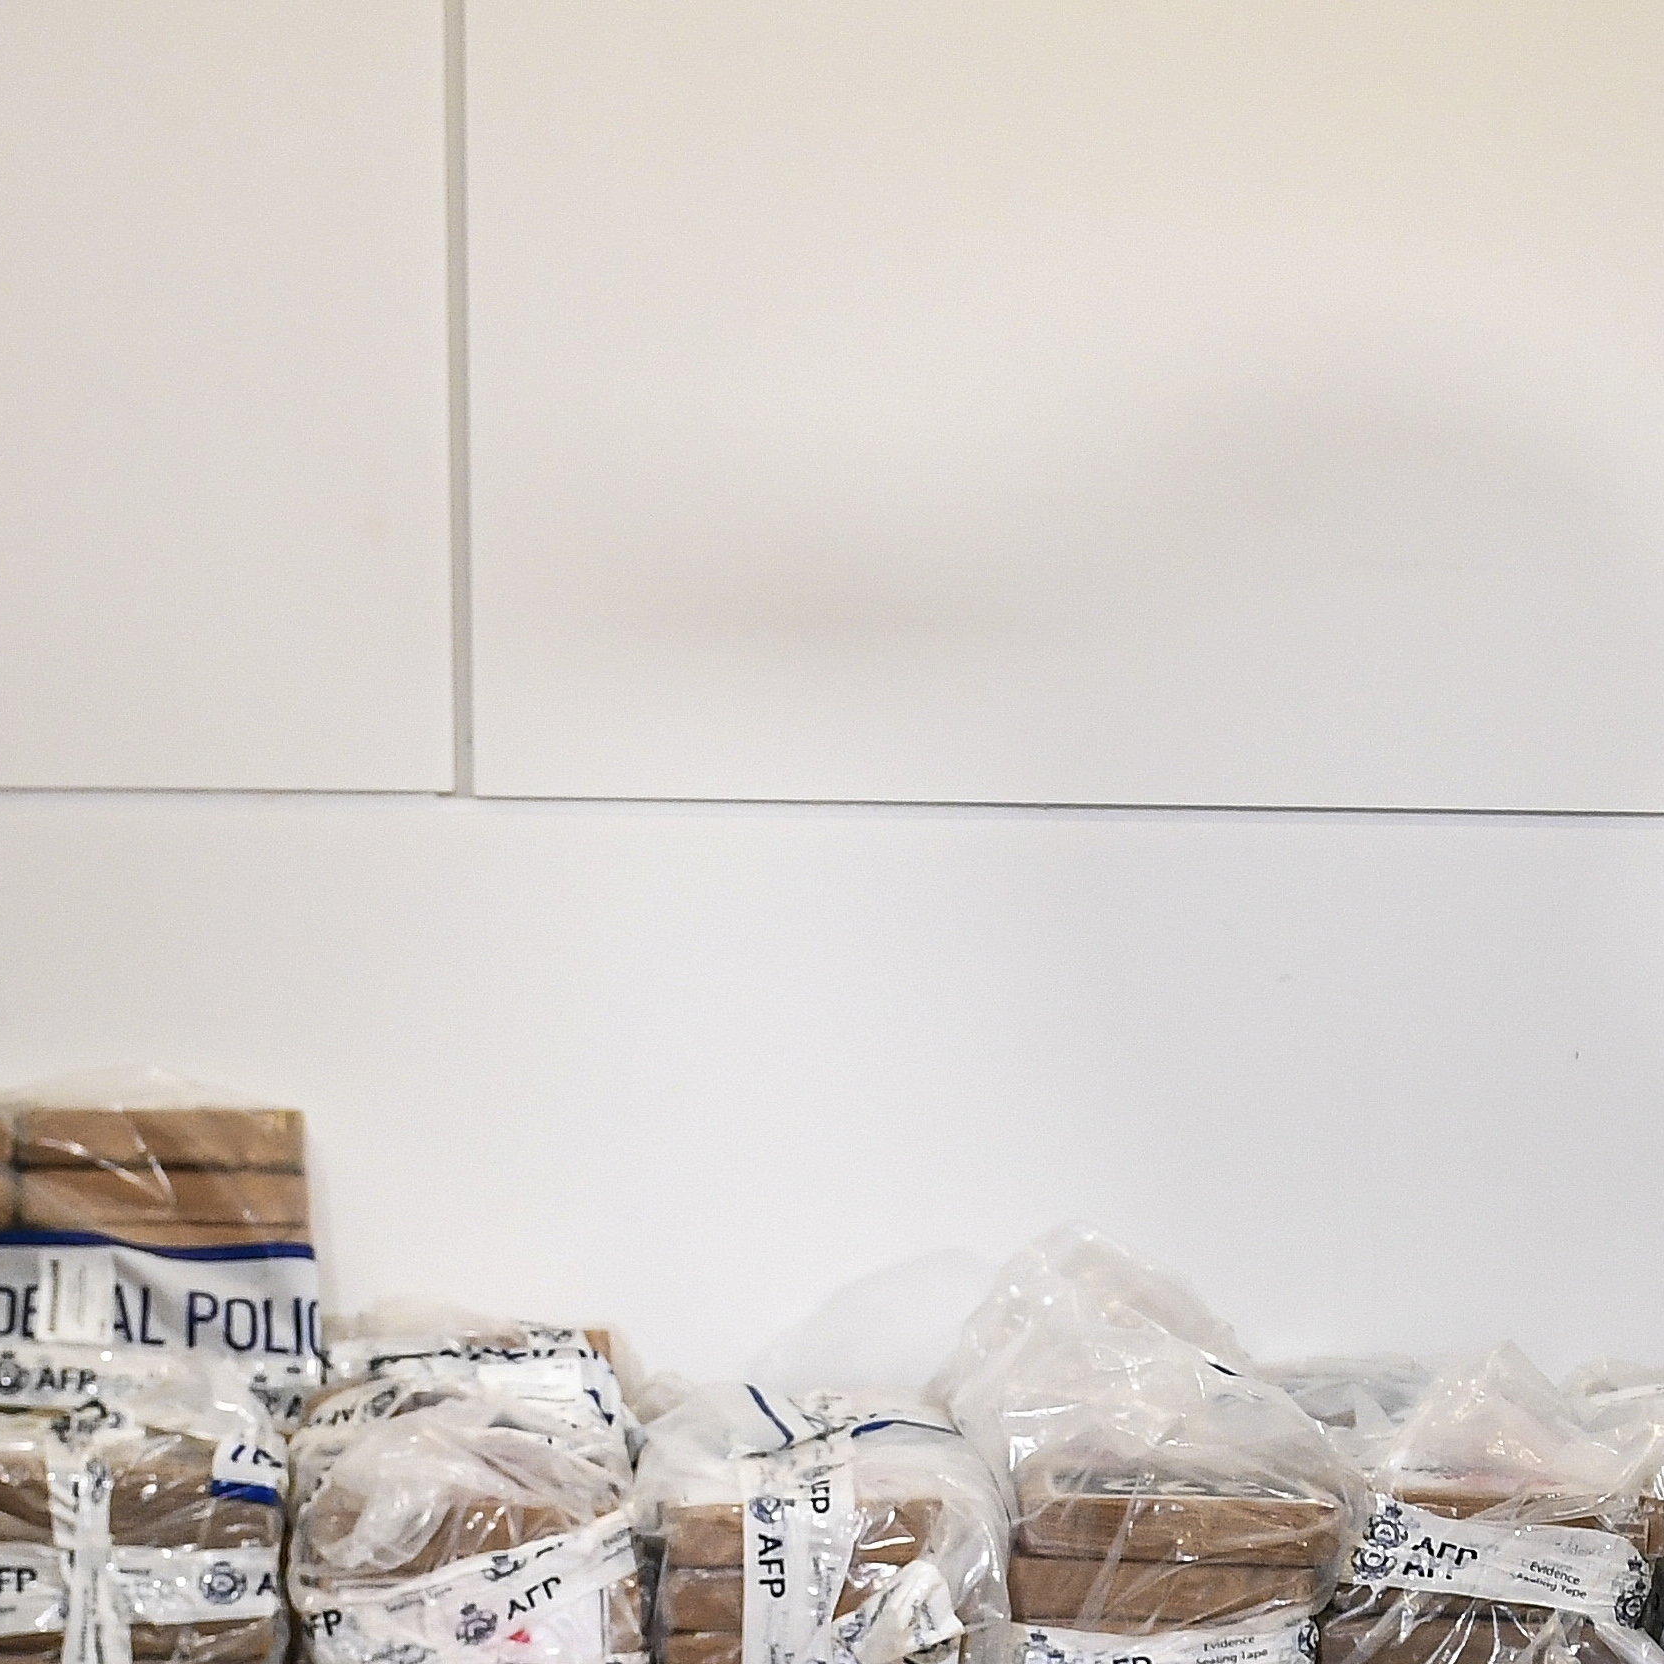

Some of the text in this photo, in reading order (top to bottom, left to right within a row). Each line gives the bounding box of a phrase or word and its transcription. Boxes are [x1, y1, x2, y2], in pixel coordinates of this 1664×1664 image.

[811, 1479, 831, 1515] FP
[758, 1533, 787, 1600] AFP
[1530, 1561, 1581, 1586] Evidence
[1202, 1635, 1256, 1652] Evidence
[1240, 1648, 1270, 1664] Tape
